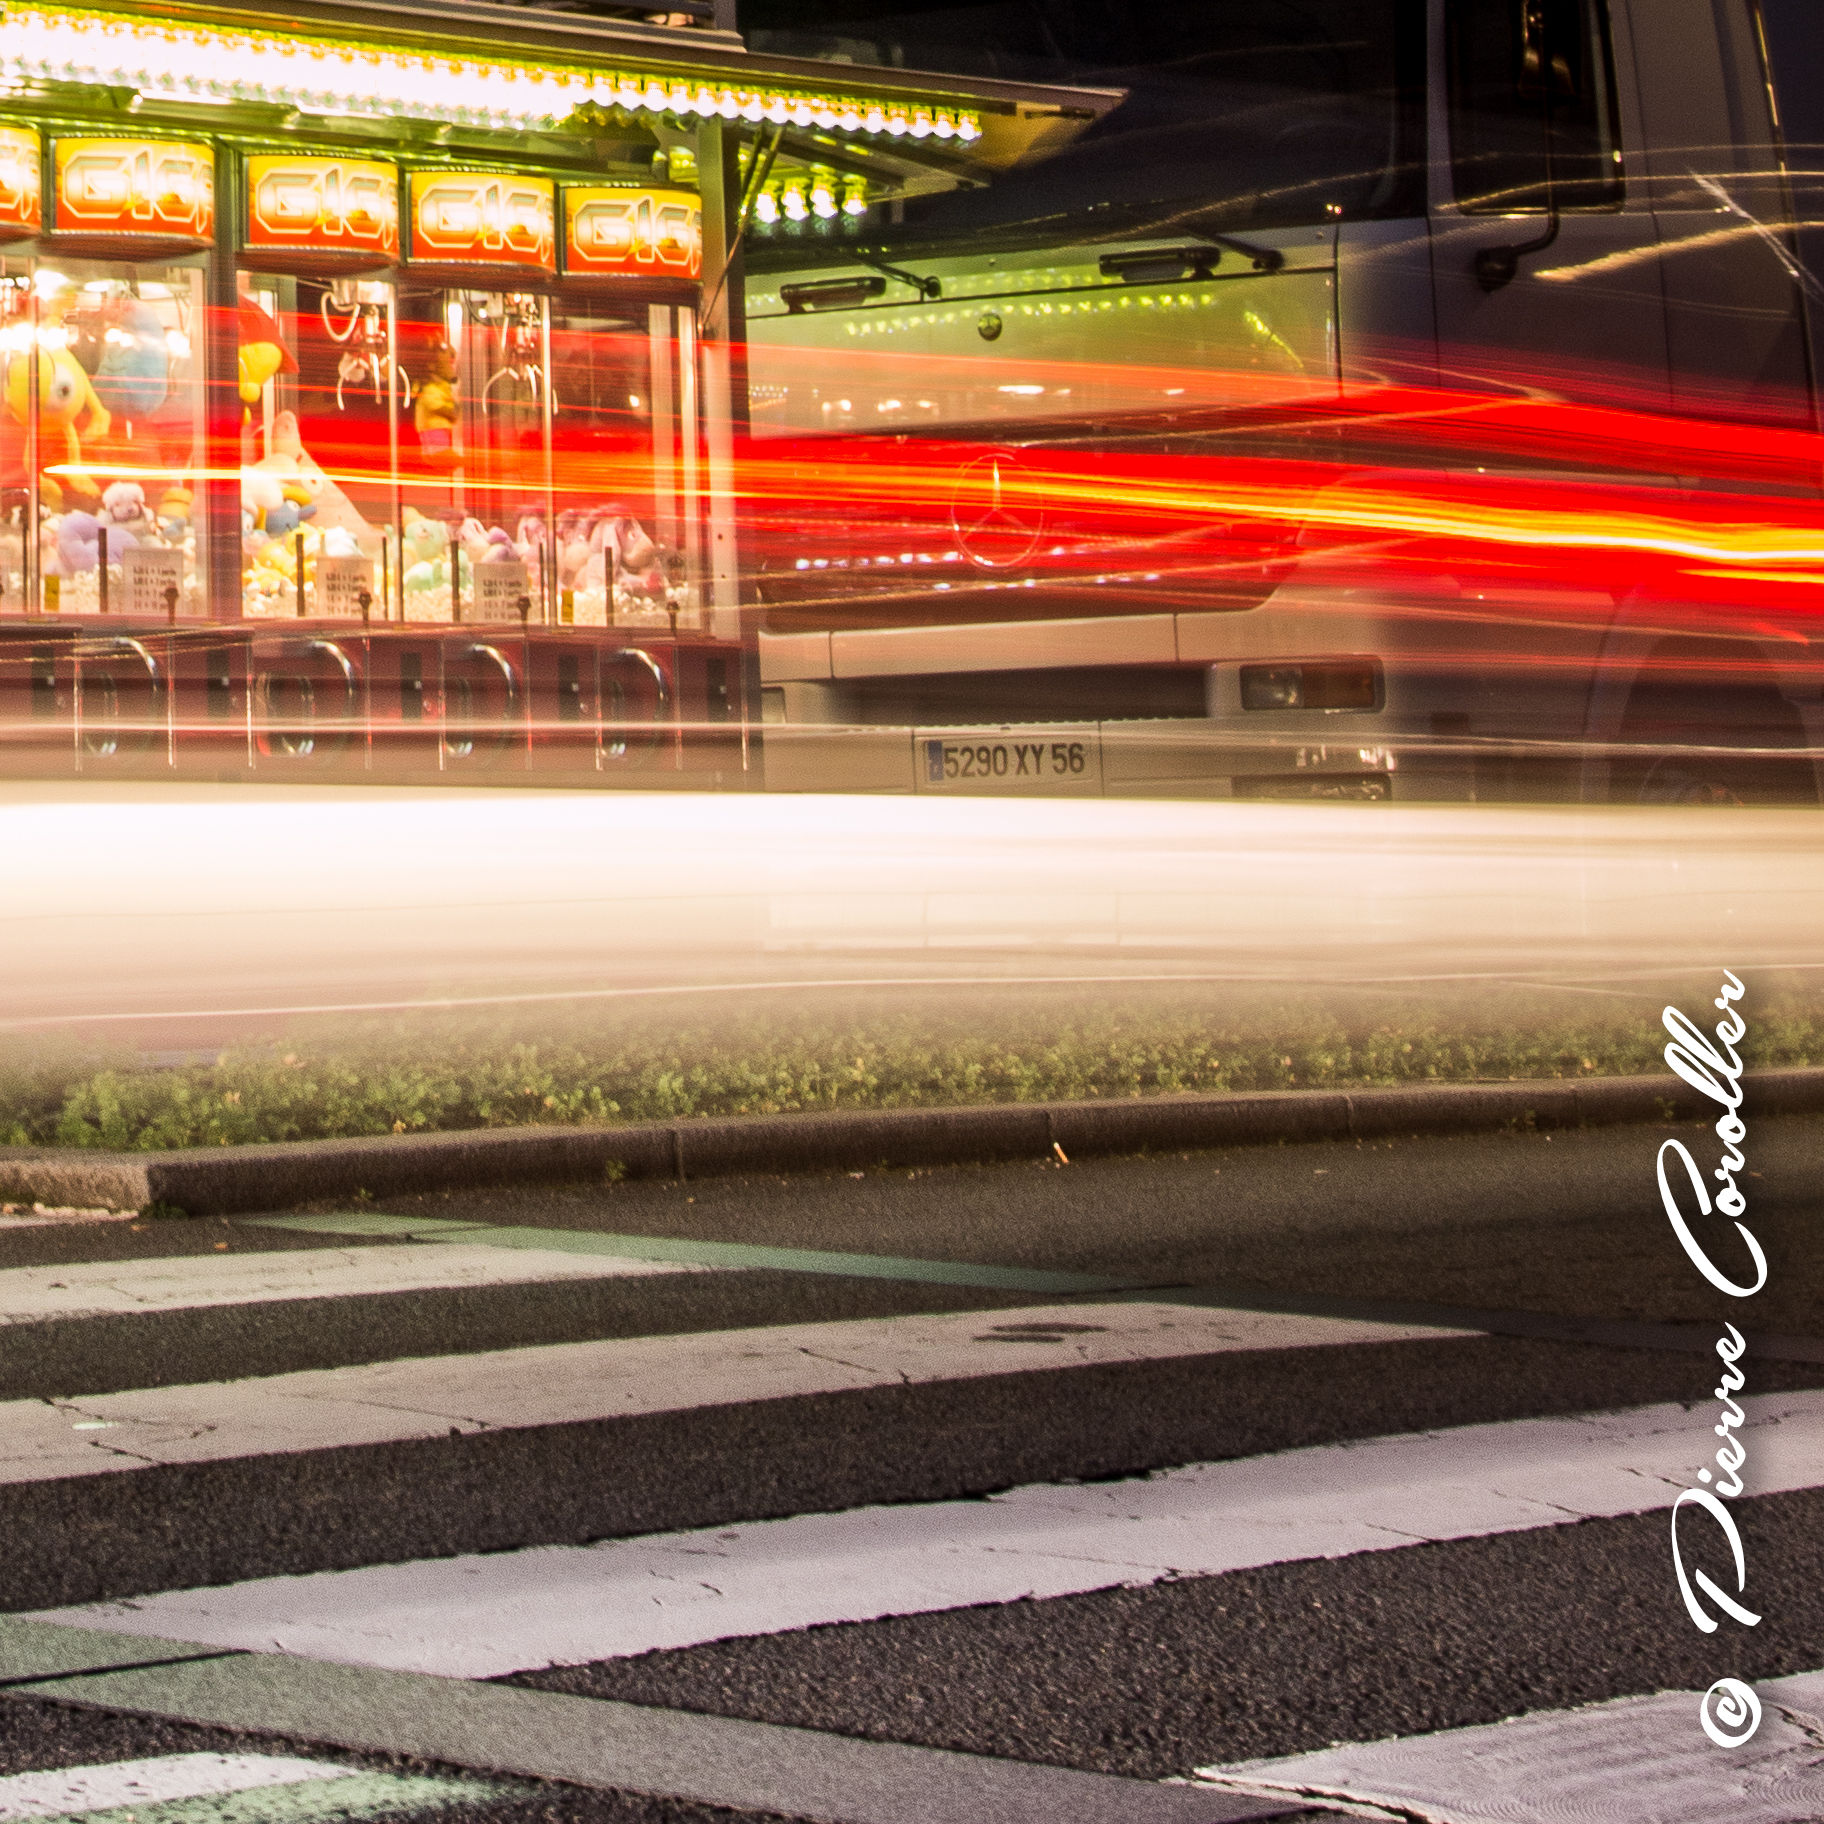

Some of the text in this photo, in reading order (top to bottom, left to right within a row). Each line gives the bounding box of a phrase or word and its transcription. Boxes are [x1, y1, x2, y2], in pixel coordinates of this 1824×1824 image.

[943, 745, 1009, 778] 5290
[1014, 743, 1044, 776] XY
[1051, 742, 1085, 774] 56
